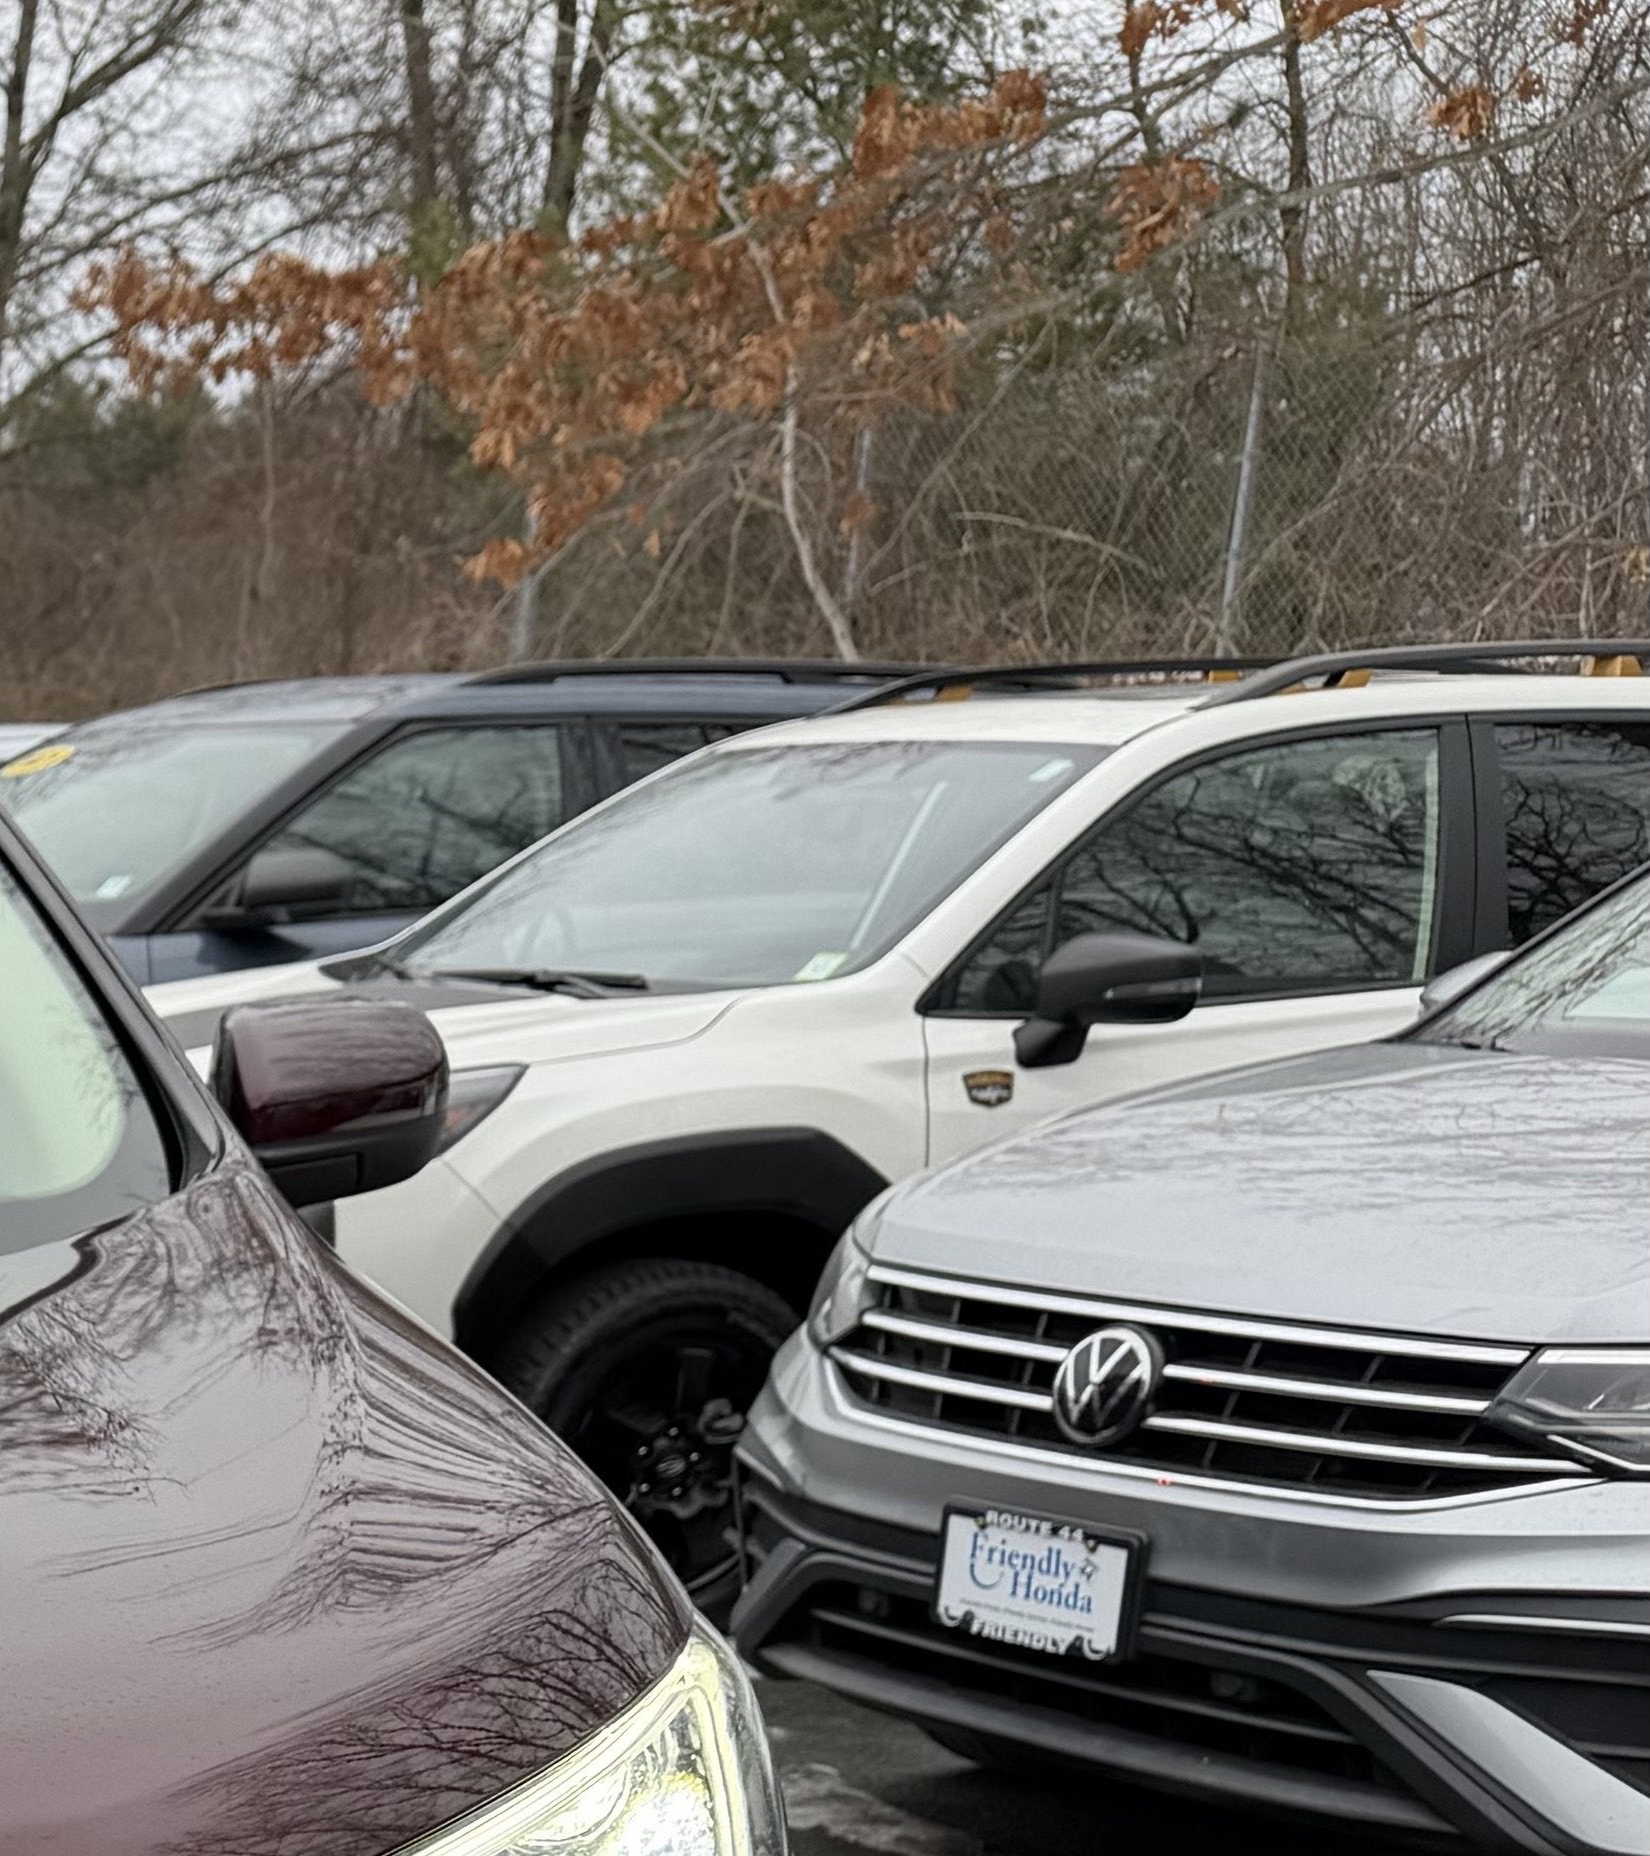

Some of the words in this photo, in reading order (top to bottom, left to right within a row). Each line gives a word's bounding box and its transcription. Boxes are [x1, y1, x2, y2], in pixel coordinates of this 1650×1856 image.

[985, 1510, 1052, 1537] ROUTE
[1058, 1525, 1084, 1543] 44
[969, 1531, 1075, 1585] Friendly
[1009, 1570, 1093, 1615] Honda
[969, 1619, 1072, 1656] FRIENDLY
